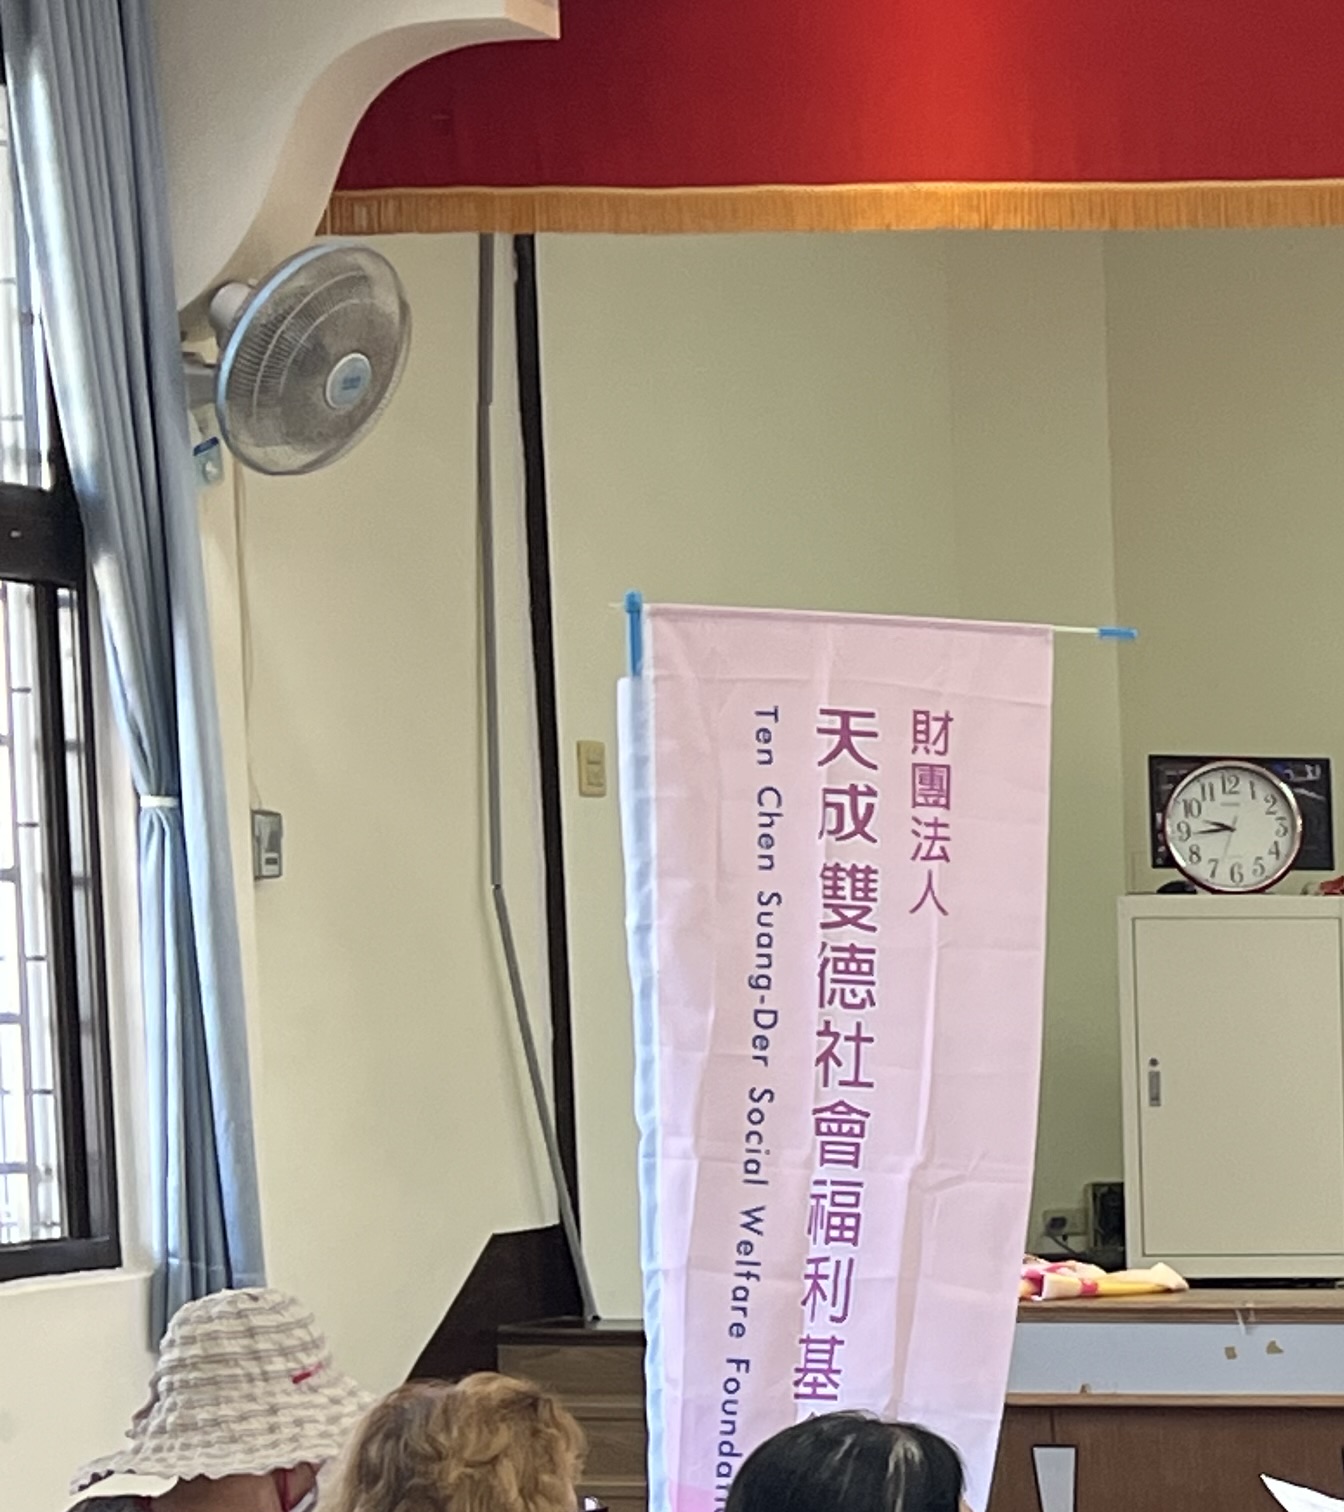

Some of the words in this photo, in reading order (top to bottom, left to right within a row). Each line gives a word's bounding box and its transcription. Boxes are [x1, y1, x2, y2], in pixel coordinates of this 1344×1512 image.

[754, 705, 779, 766] Ten
[1201, 781, 1216, 801] 11
[1220, 772, 1240, 795] 12
[1249, 780, 1257, 800] 1
[909, 709, 954, 917] 財團法人
[1182, 798, 1201, 818] 10
[1263, 794, 1277, 815] 2
[757, 786, 784, 872] Chen
[1176, 821, 1191, 842] 9
[1274, 816, 1288, 837] 3
[1188, 844, 1201, 864] 8
[1268, 840, 1280, 860] 4
[1208, 859, 1219, 878] 7
[1230, 862, 1243, 885] 6
[1252, 856, 1265, 877] 5
[748, 891, 782, 1068] Suang-Der
[793, 706, 880, 1420] 天成雙德社會福利基
[742, 1086, 774, 1186] Social
[727, 1205, 767, 1340] Welfare
